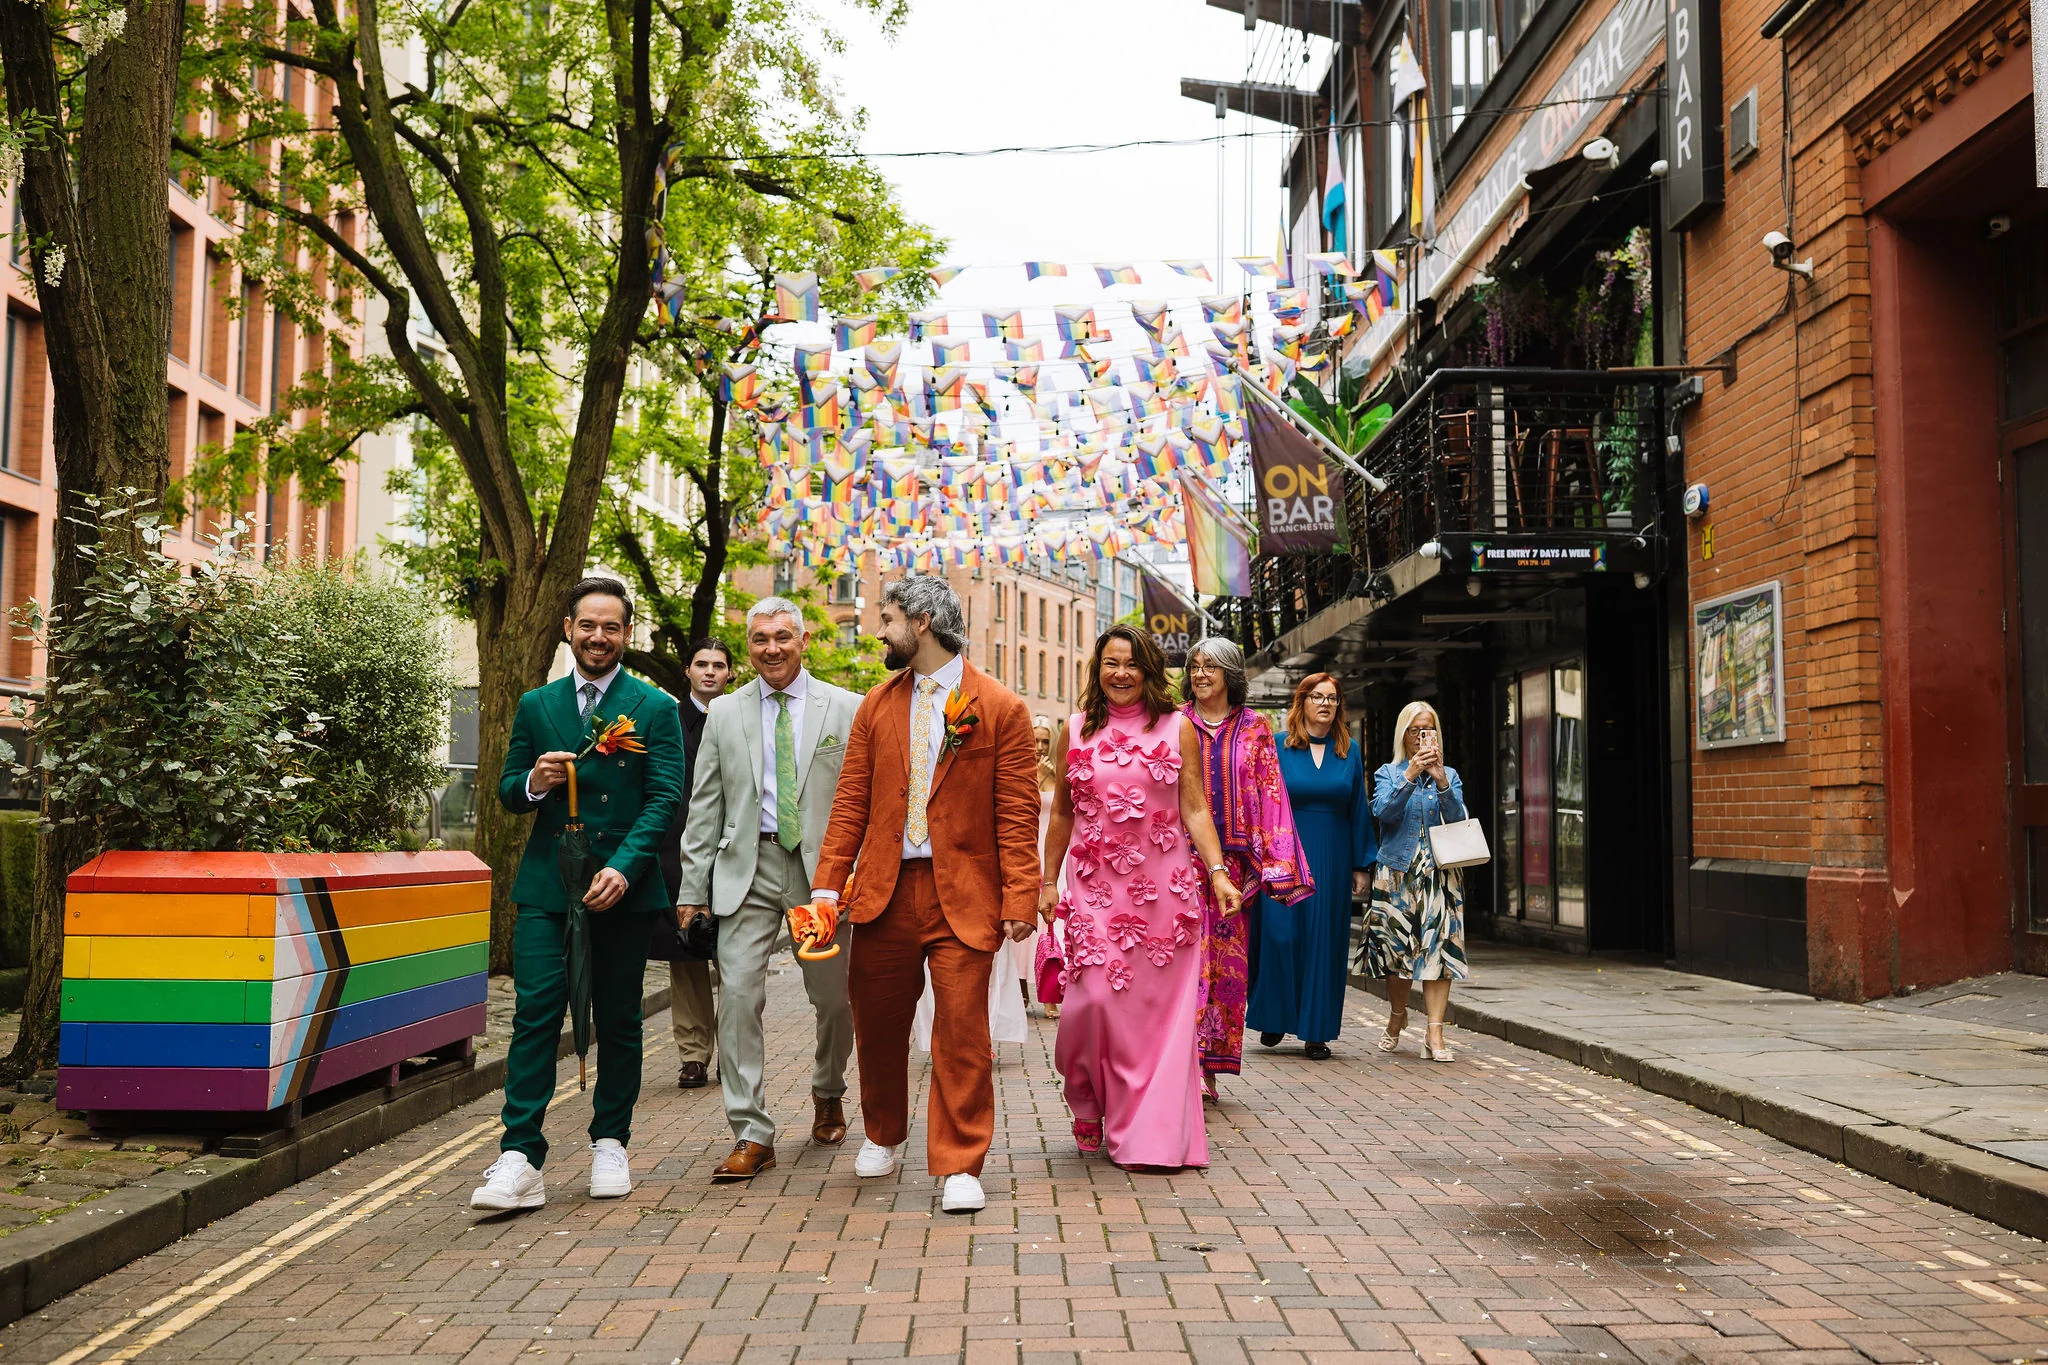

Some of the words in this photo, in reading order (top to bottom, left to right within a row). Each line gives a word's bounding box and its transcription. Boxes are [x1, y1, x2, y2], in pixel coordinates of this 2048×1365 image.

[1264, 464, 1329, 499] ON
[1267, 496, 1334, 526] BAR
[1270, 522, 1335, 534] MANCHESTER
[1487, 549, 1505, 558] FREE
[1506, 549, 1530, 558] ENTRY
[1532, 549, 1537, 558] 7
[1539, 549, 1560, 558] DAYS
[1561, 549, 1567, 558] A
[1569, 549, 1591, 558] WEEK
[1517, 559, 1529, 567] OPEN
[1150, 613, 1188, 635] ON
